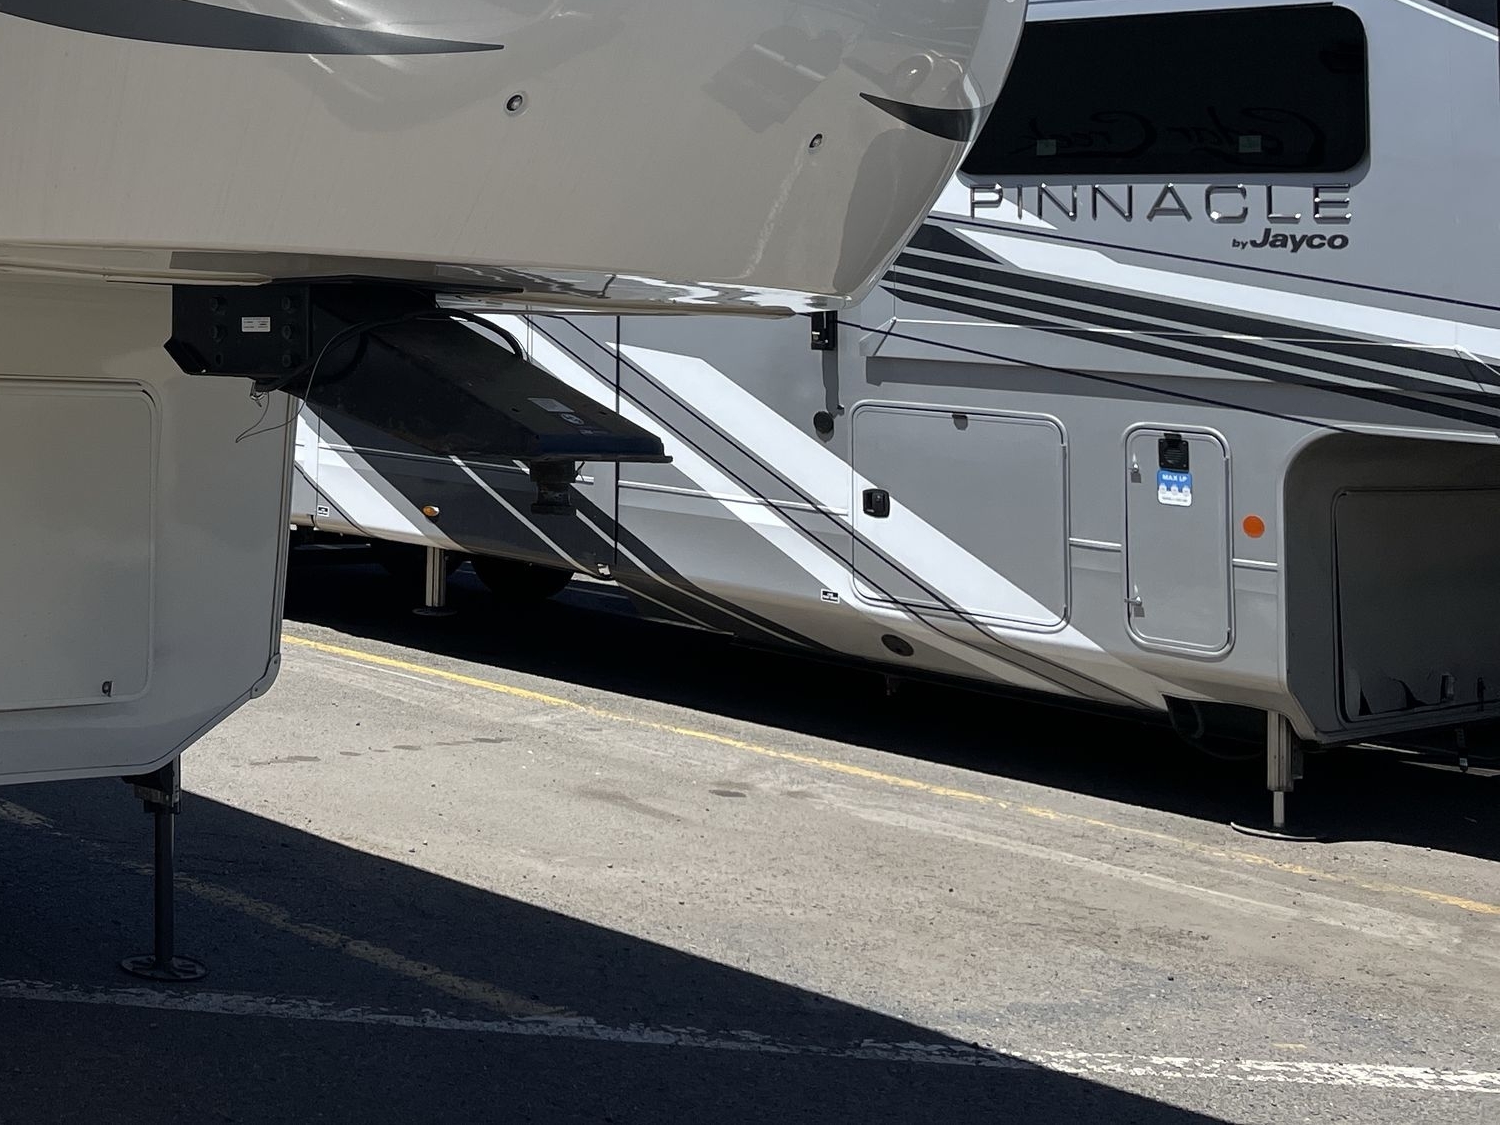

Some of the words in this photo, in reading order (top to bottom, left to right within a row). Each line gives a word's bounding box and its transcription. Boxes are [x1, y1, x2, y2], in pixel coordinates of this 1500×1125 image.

[969, 183, 1352, 223] PINNACLE
[1231, 238, 1248, 250] by
[1249, 228, 1350, 253] Jayco
[1161, 473, 1178, 481] MAX
